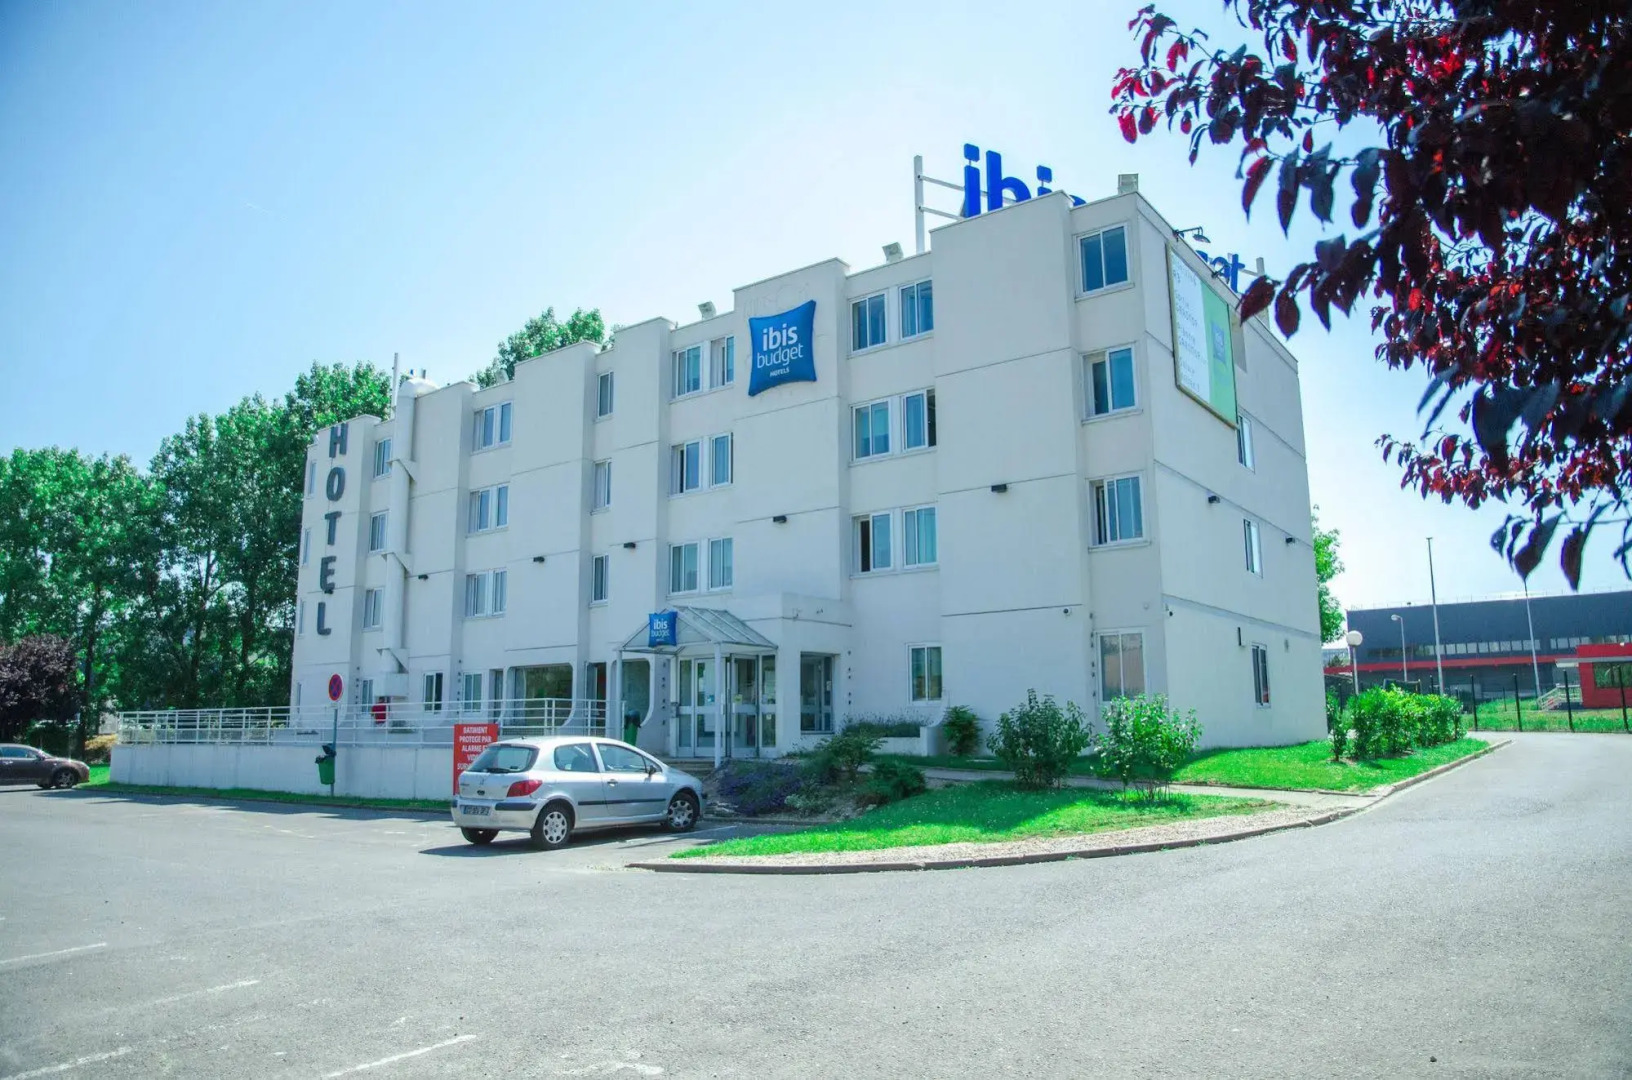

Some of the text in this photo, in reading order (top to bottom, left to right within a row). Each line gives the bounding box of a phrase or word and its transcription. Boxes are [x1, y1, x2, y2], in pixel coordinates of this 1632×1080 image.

[964, 143, 1087, 218] ib
[762, 323, 798, 351] ibis
[757, 343, 804, 369] budget
[769, 366, 790, 377] HOTELS
[317, 422, 349, 636] HOTEL
[653, 618, 668, 630] ibis
[463, 726, 488, 734] BATIMENT
[482, 735, 492, 743] PAR
[462, 744, 481, 752] ALARME
